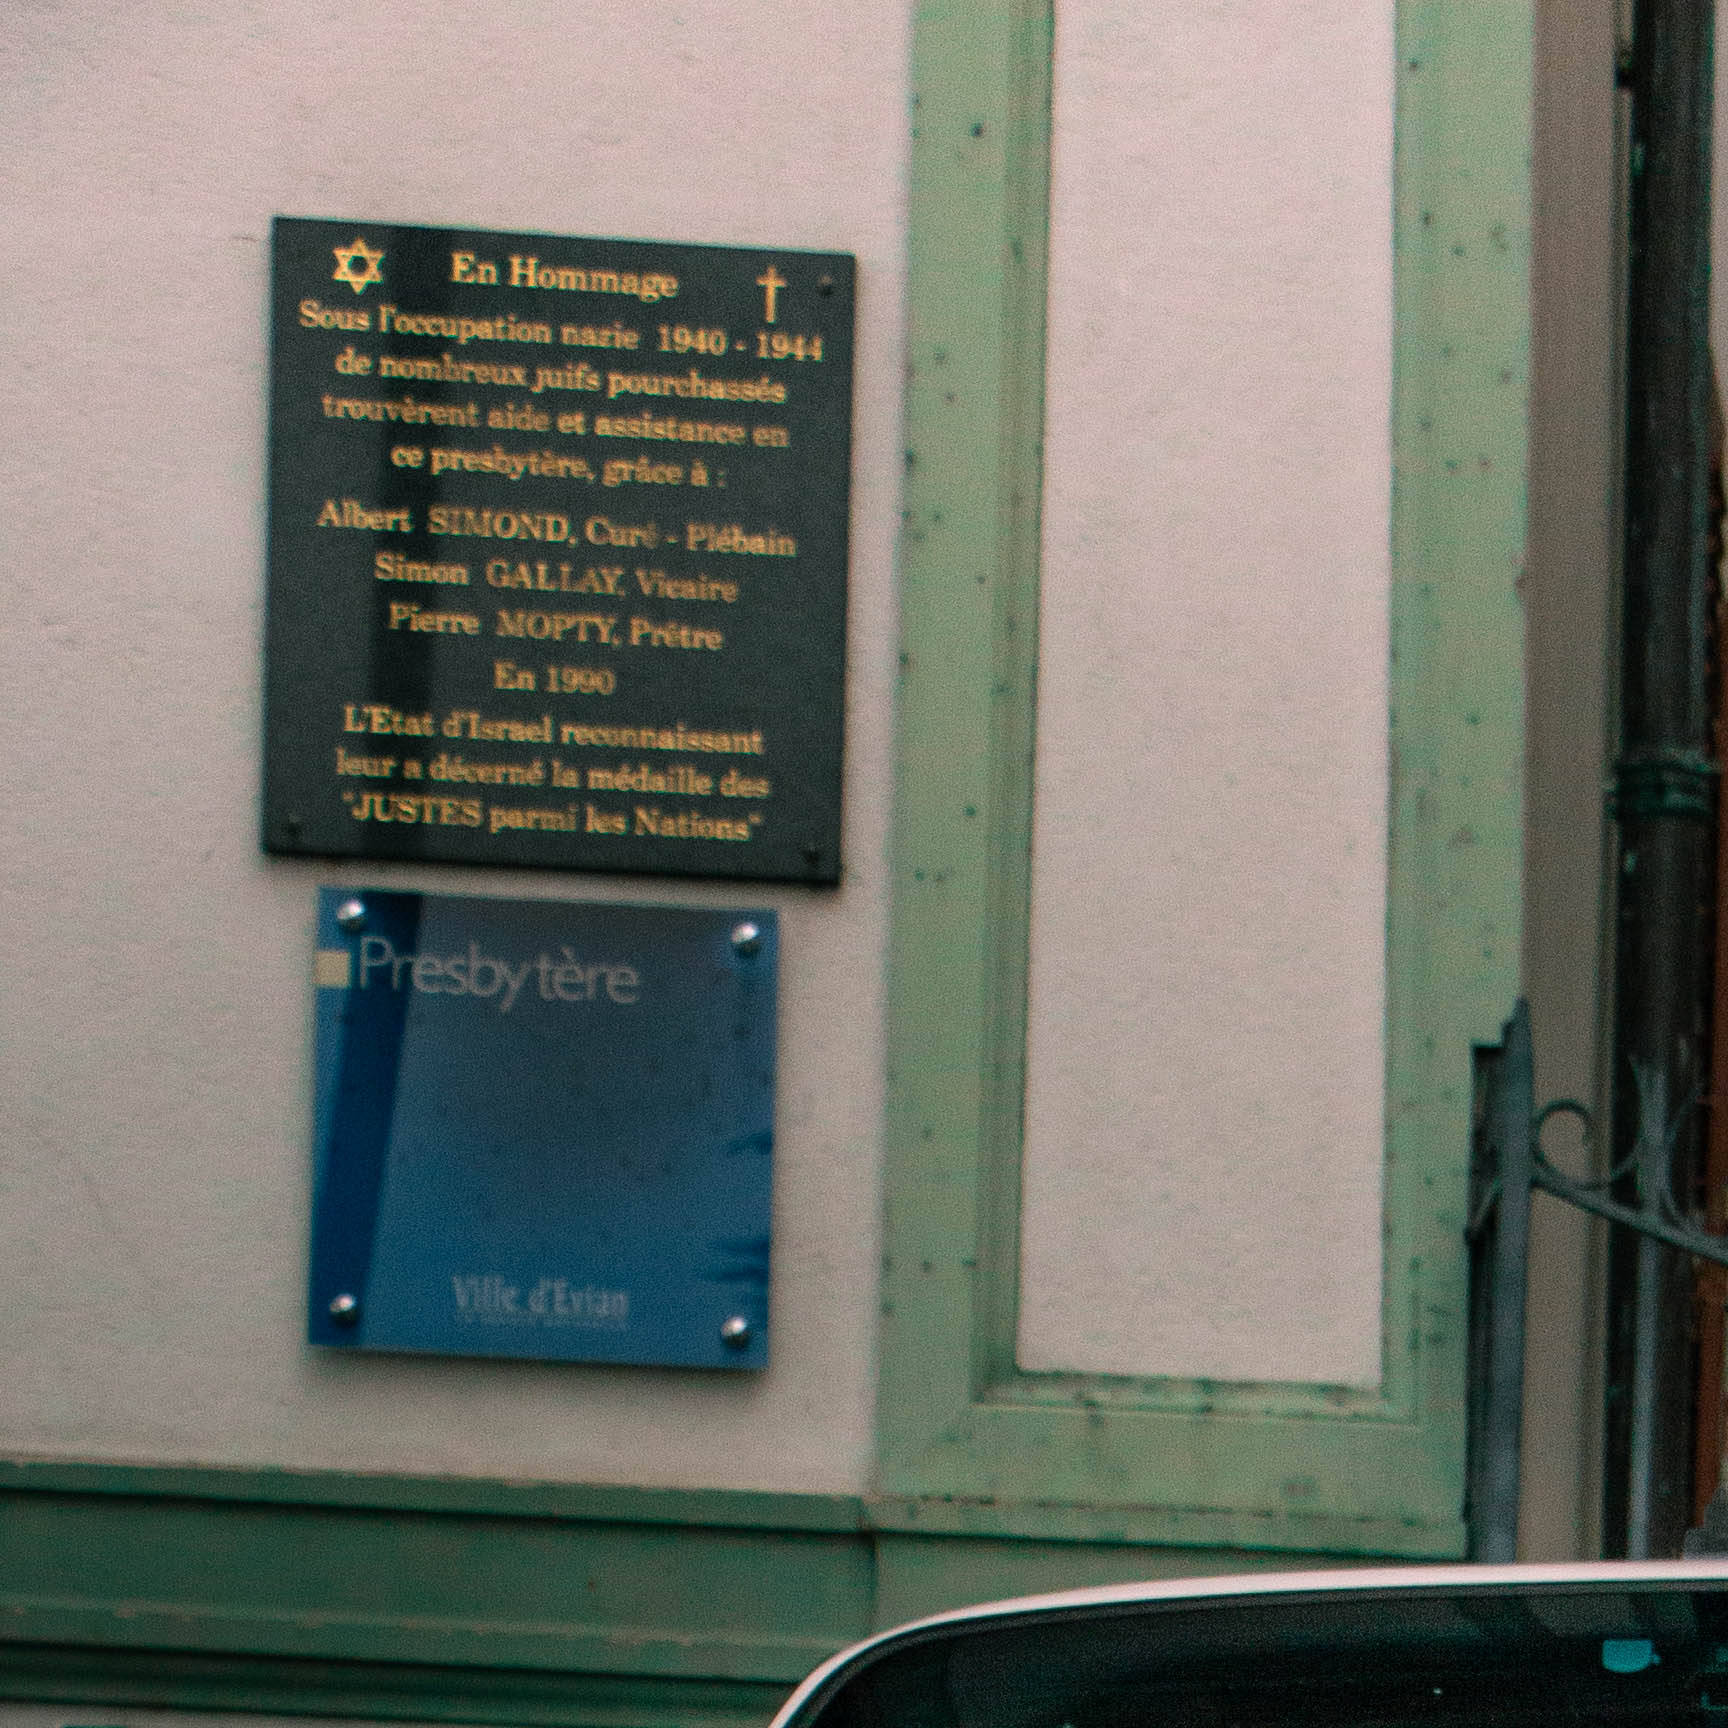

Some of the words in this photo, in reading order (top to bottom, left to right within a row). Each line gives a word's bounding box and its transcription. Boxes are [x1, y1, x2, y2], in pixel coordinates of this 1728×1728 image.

[451, 251, 498, 284] En
[509, 254, 678, 303] Hommage
[299, 299, 370, 331] Sous
[378, 304, 551, 344] l'occupation
[657, 324, 727, 356] 1940
[757, 331, 823, 362] 1944
[334, 346, 373, 375] de
[379, 353, 527, 386] nombreux
[531, 361, 600, 393] juifs
[607, 368, 786, 404] pourchassés
[321, 393, 479, 427] trouvèrent
[487, 401, 550, 431] aide
[556, 411, 585, 435] et
[594, 410, 746, 446] assistance
[752, 425, 790, 447] en
[390, 447, 424, 468] ce
[602, 455, 683, 487] grâce
[690, 458, 708, 487] à
[316, 499, 413, 533] Albert
[374, 551, 470, 585] Simon
[635, 567, 740, 603] Vicaire
[388, 601, 481, 635] Pierre
[629, 615, 724, 650] Prêtre
[493, 659, 537, 692] En
[343, 704, 434, 738] L'Etat
[559, 720, 764, 756] reconnaissant
[336, 746, 396, 779] leur
[403, 759, 424, 780] a
[429, 753, 544, 787] décerné
[552, 758, 579, 788] la
[587, 763, 714, 796] médaille
[720, 768, 771, 799] des
[490, 804, 577, 834] parmi
[585, 803, 629, 836] les
[358, 935, 639, 1014] Presbytère
[453, 1274, 518, 1312] Ville
